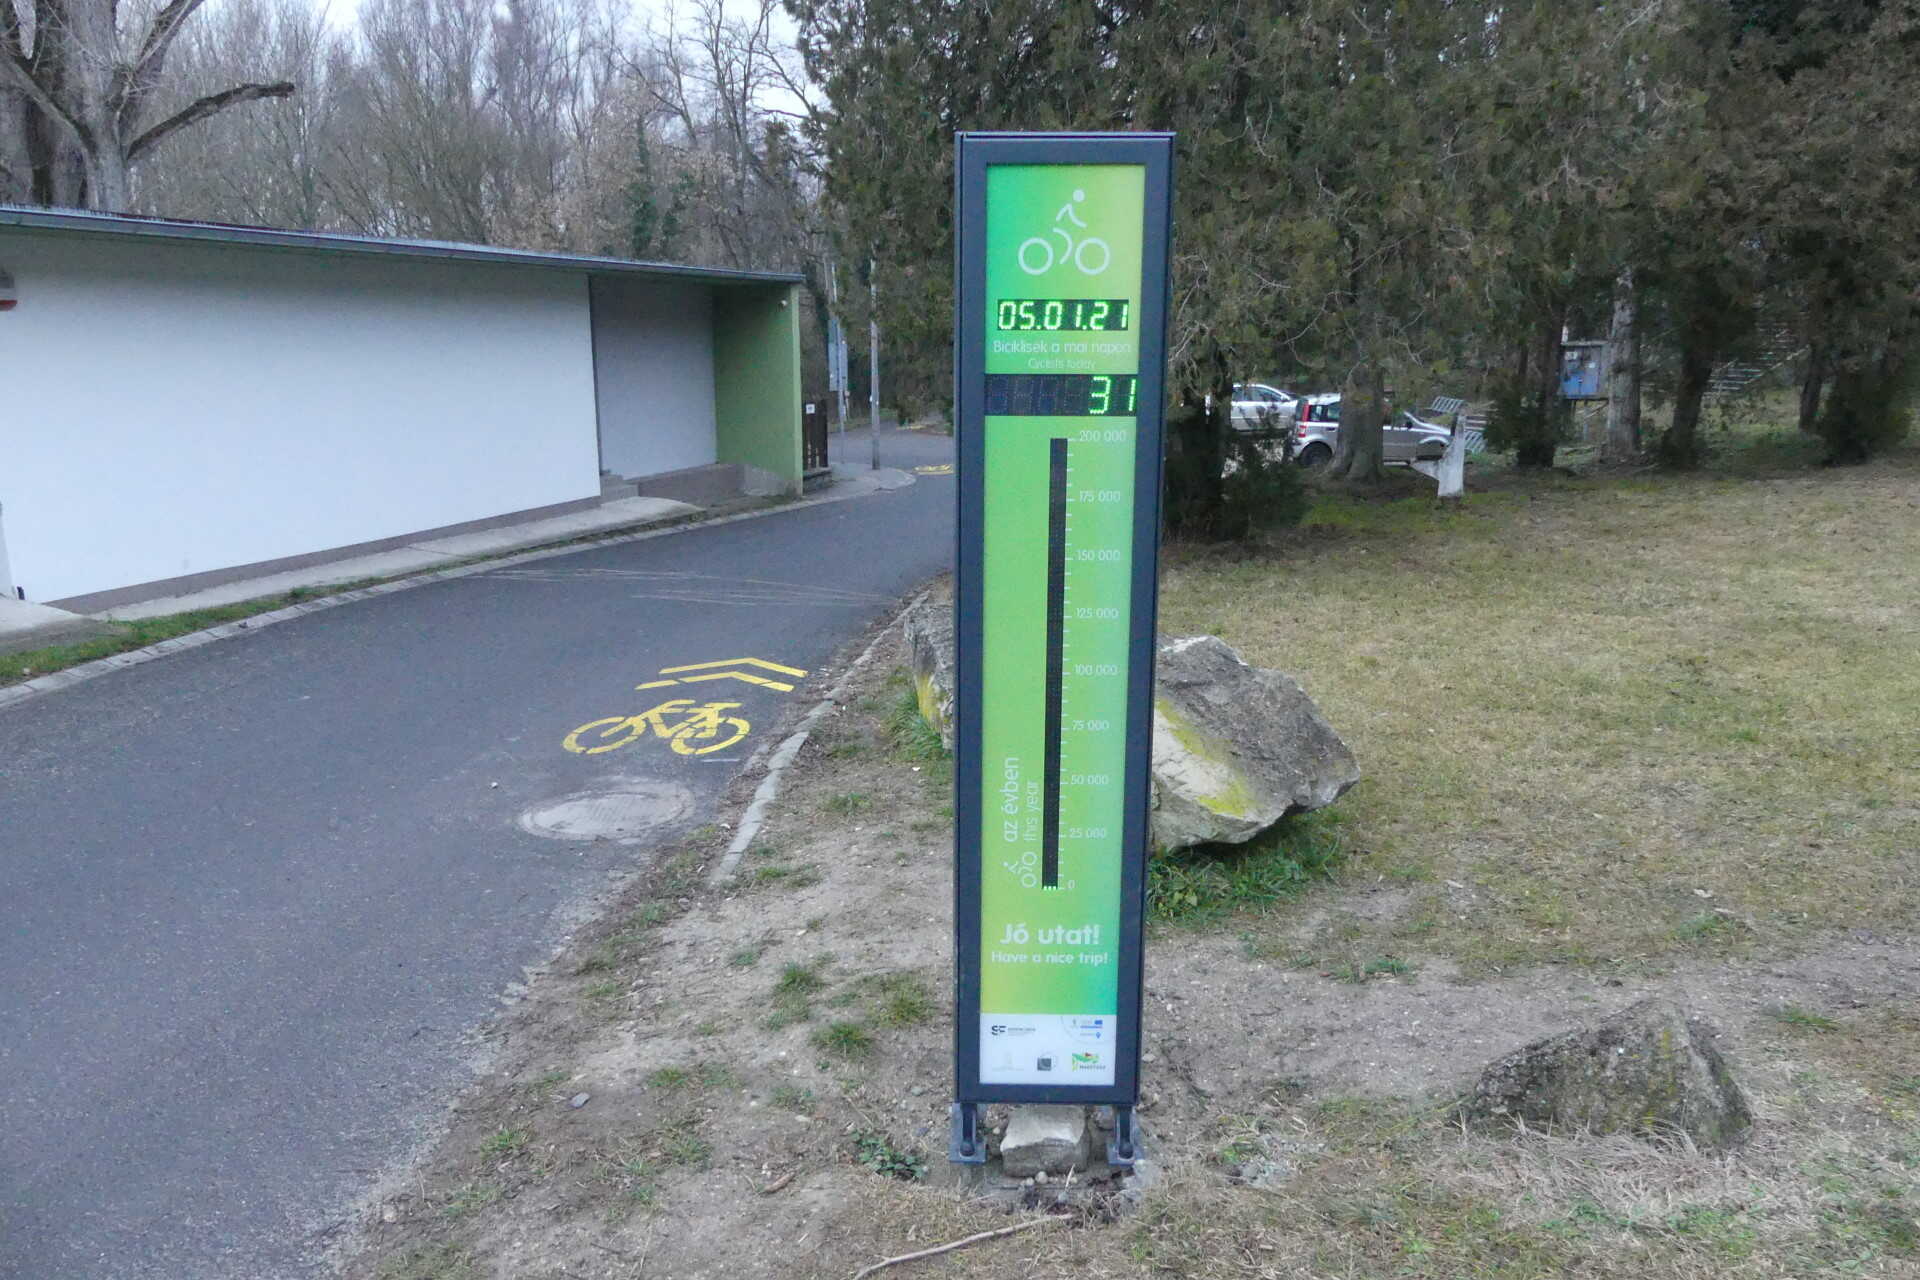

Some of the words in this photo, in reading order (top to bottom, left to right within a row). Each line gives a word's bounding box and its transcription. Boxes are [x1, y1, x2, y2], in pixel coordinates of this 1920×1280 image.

[998, 301, 1128, 330] 05.01.21
[1052, 343, 1060, 353] a
[1064, 340, 1088, 353] mai
[1092, 343, 1131, 356] napon
[1089, 375, 1137, 415] 31
[1079, 430, 1100, 442] 200
[1104, 430, 1127, 442] 000
[1079, 491, 1095, 502] 175
[1098, 491, 1121, 502] 000
[1077, 550, 1094, 561] 150
[1098, 550, 1121, 561] 000
[1076, 607, 1093, 618] 125
[1096, 607, 1119, 618] 000
[1074, 664, 1093, 676] 100
[1095, 664, 1118, 676] 000
[1072, 720, 1084, 731] 75
[1087, 720, 1110, 731] 000
[1071, 774, 1084, 785] 50
[1086, 774, 1109, 785] 000
[1000, 757, 1019, 816] évben
[1025, 780, 1041, 812] year
[1003, 820, 1018, 842] az
[1069, 828, 1083, 839] 25
[1085, 828, 1107, 839] 000
[1067, 880, 1076, 889] 0
[999, 923, 1029, 945] Jó
[1038, 924, 1100, 945] utat!
[991, 951, 1028, 964] Have
[1032, 953, 1041, 963] a
[1045, 951, 1075, 964] nice
[1079, 951, 1109, 966] trip!
